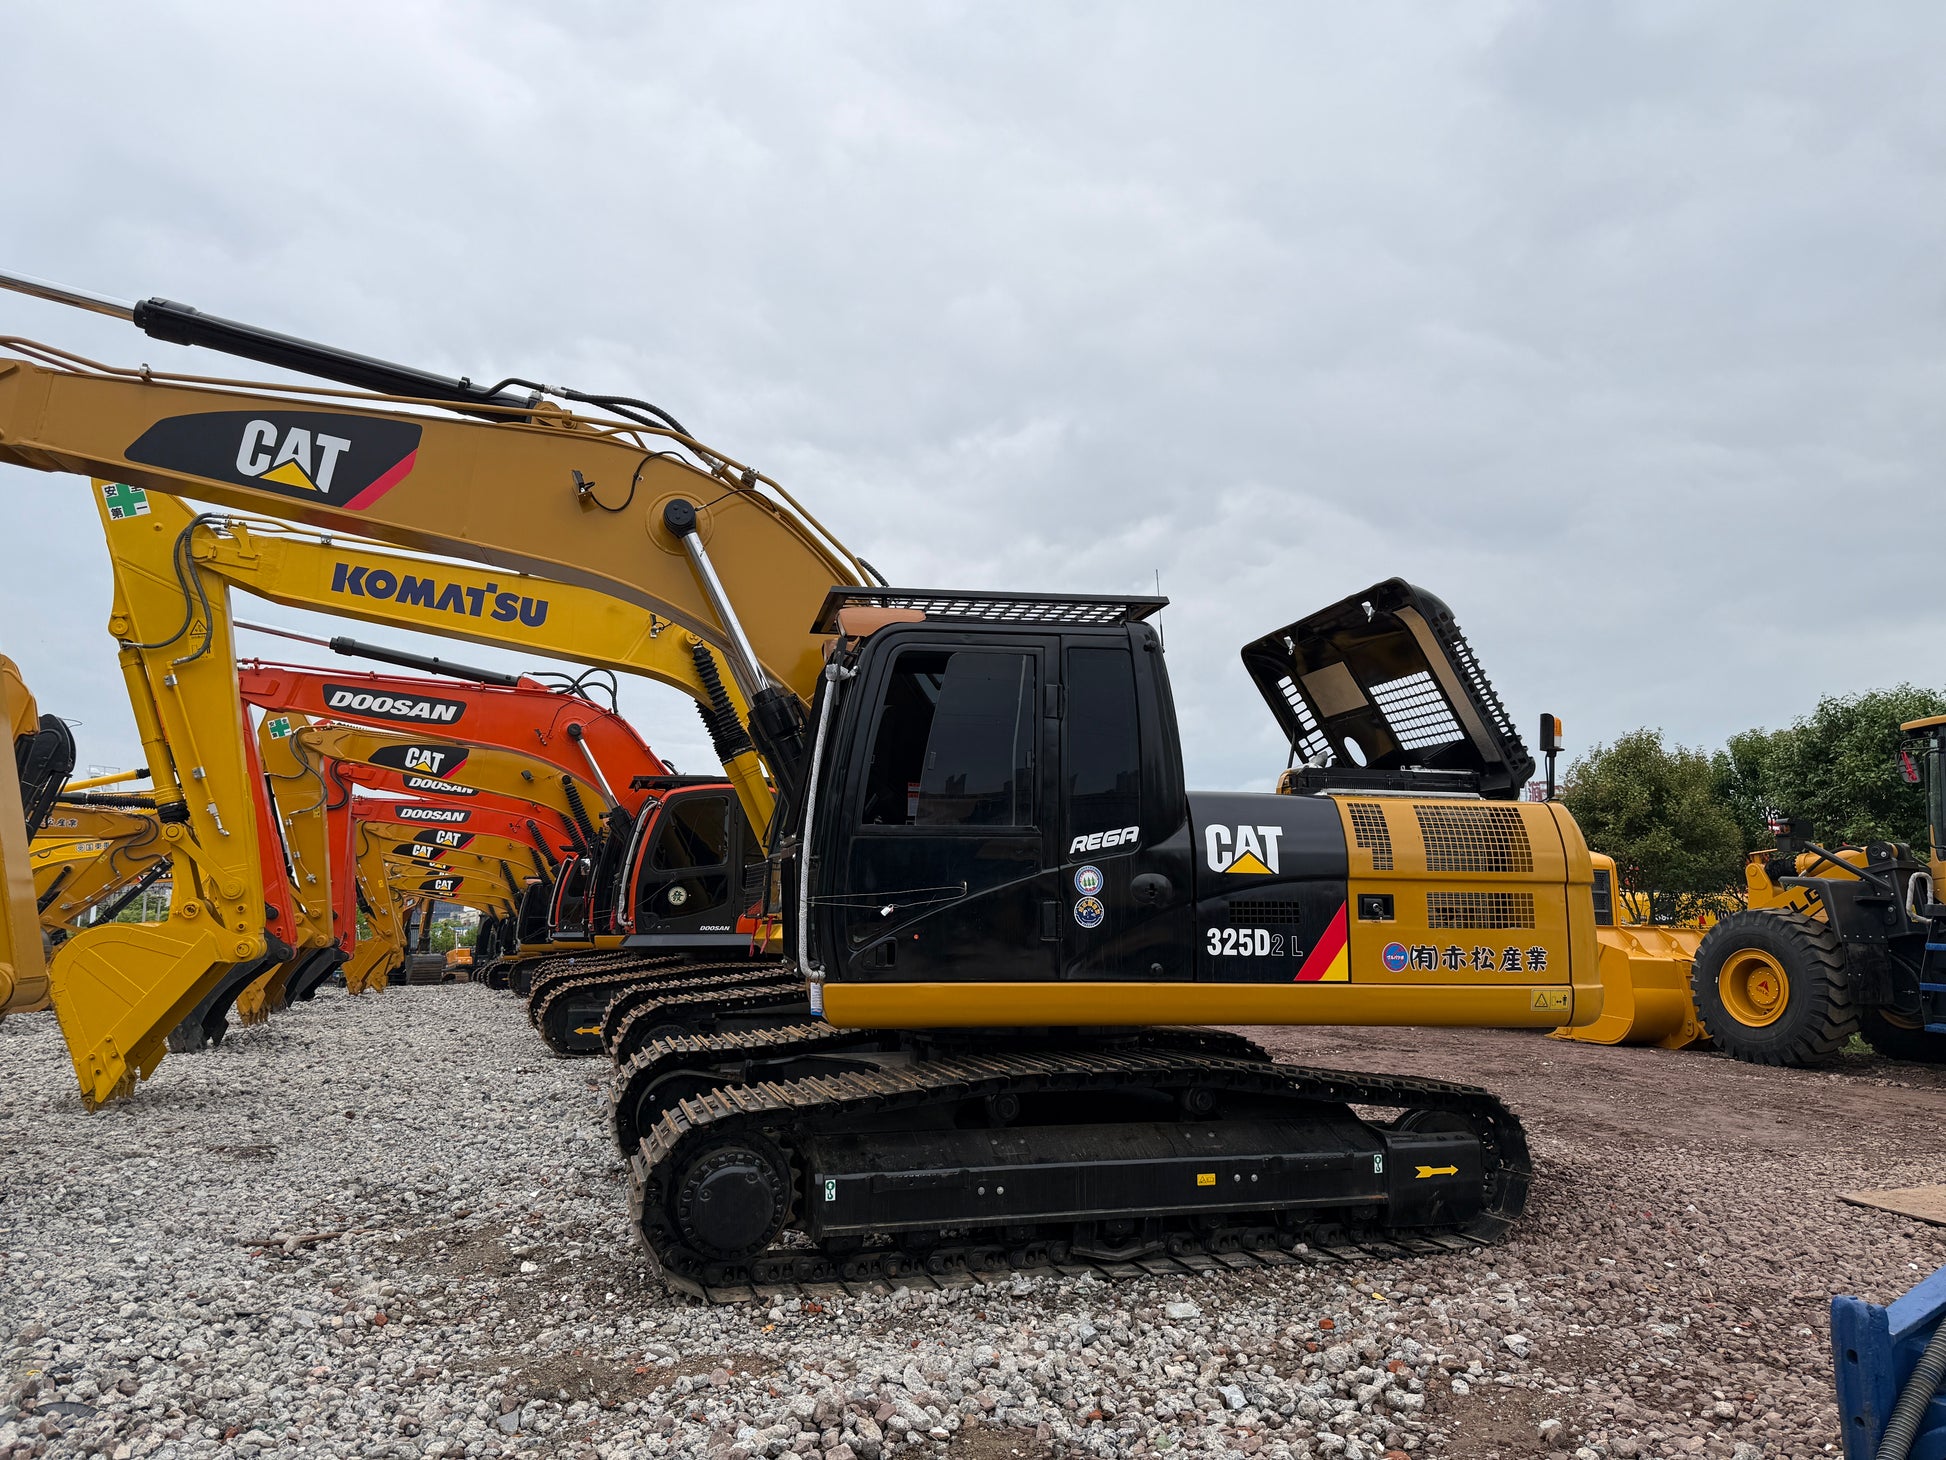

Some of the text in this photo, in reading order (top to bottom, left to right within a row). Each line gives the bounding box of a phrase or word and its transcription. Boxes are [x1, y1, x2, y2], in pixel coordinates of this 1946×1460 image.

[236, 420, 351, 493] CAT
[331, 562, 549, 627] KOMATSU
[329, 691, 458, 721] DOOSAN
[404, 747, 445, 774] CAT
[400, 808, 466, 822] DOOSAN
[412, 844, 434, 859] CAT
[435, 830, 462, 847] CAT
[1069, 825, 1140, 854] REGA
[1205, 823, 1283, 875] CAT
[435, 880, 454, 891] CAT
[1783, 888, 1821, 914] LG
[1409, 944, 1549, 972] (有)赤松産業
